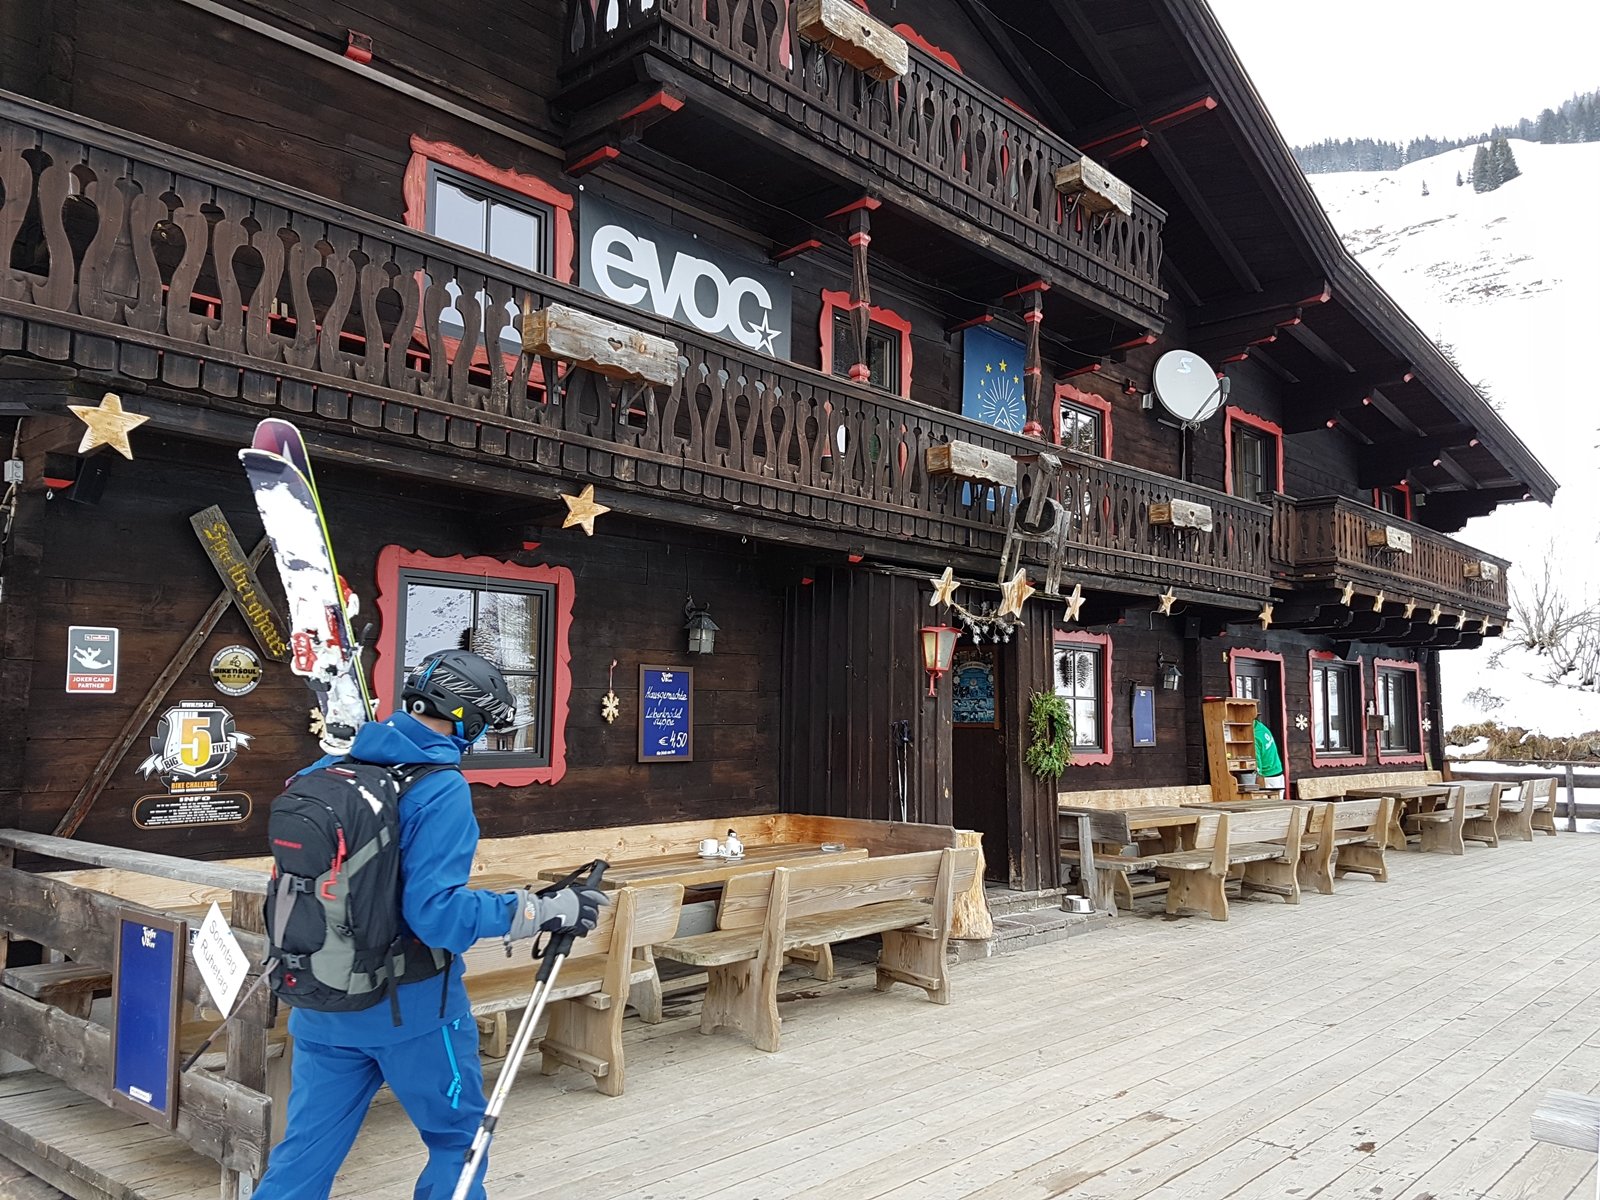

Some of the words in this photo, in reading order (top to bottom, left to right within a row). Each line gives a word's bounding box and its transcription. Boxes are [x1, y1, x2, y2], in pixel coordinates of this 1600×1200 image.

[591, 225, 773, 348] evoc
[164, 756, 179, 770] BIG
[180, 716, 212, 768] 5
[212, 743, 228, 754] FIVE
[186, 780, 218, 788] CHALLENGE
[200, 938, 229, 995] Ruhetag
[209, 919, 237, 975] Sonntag
